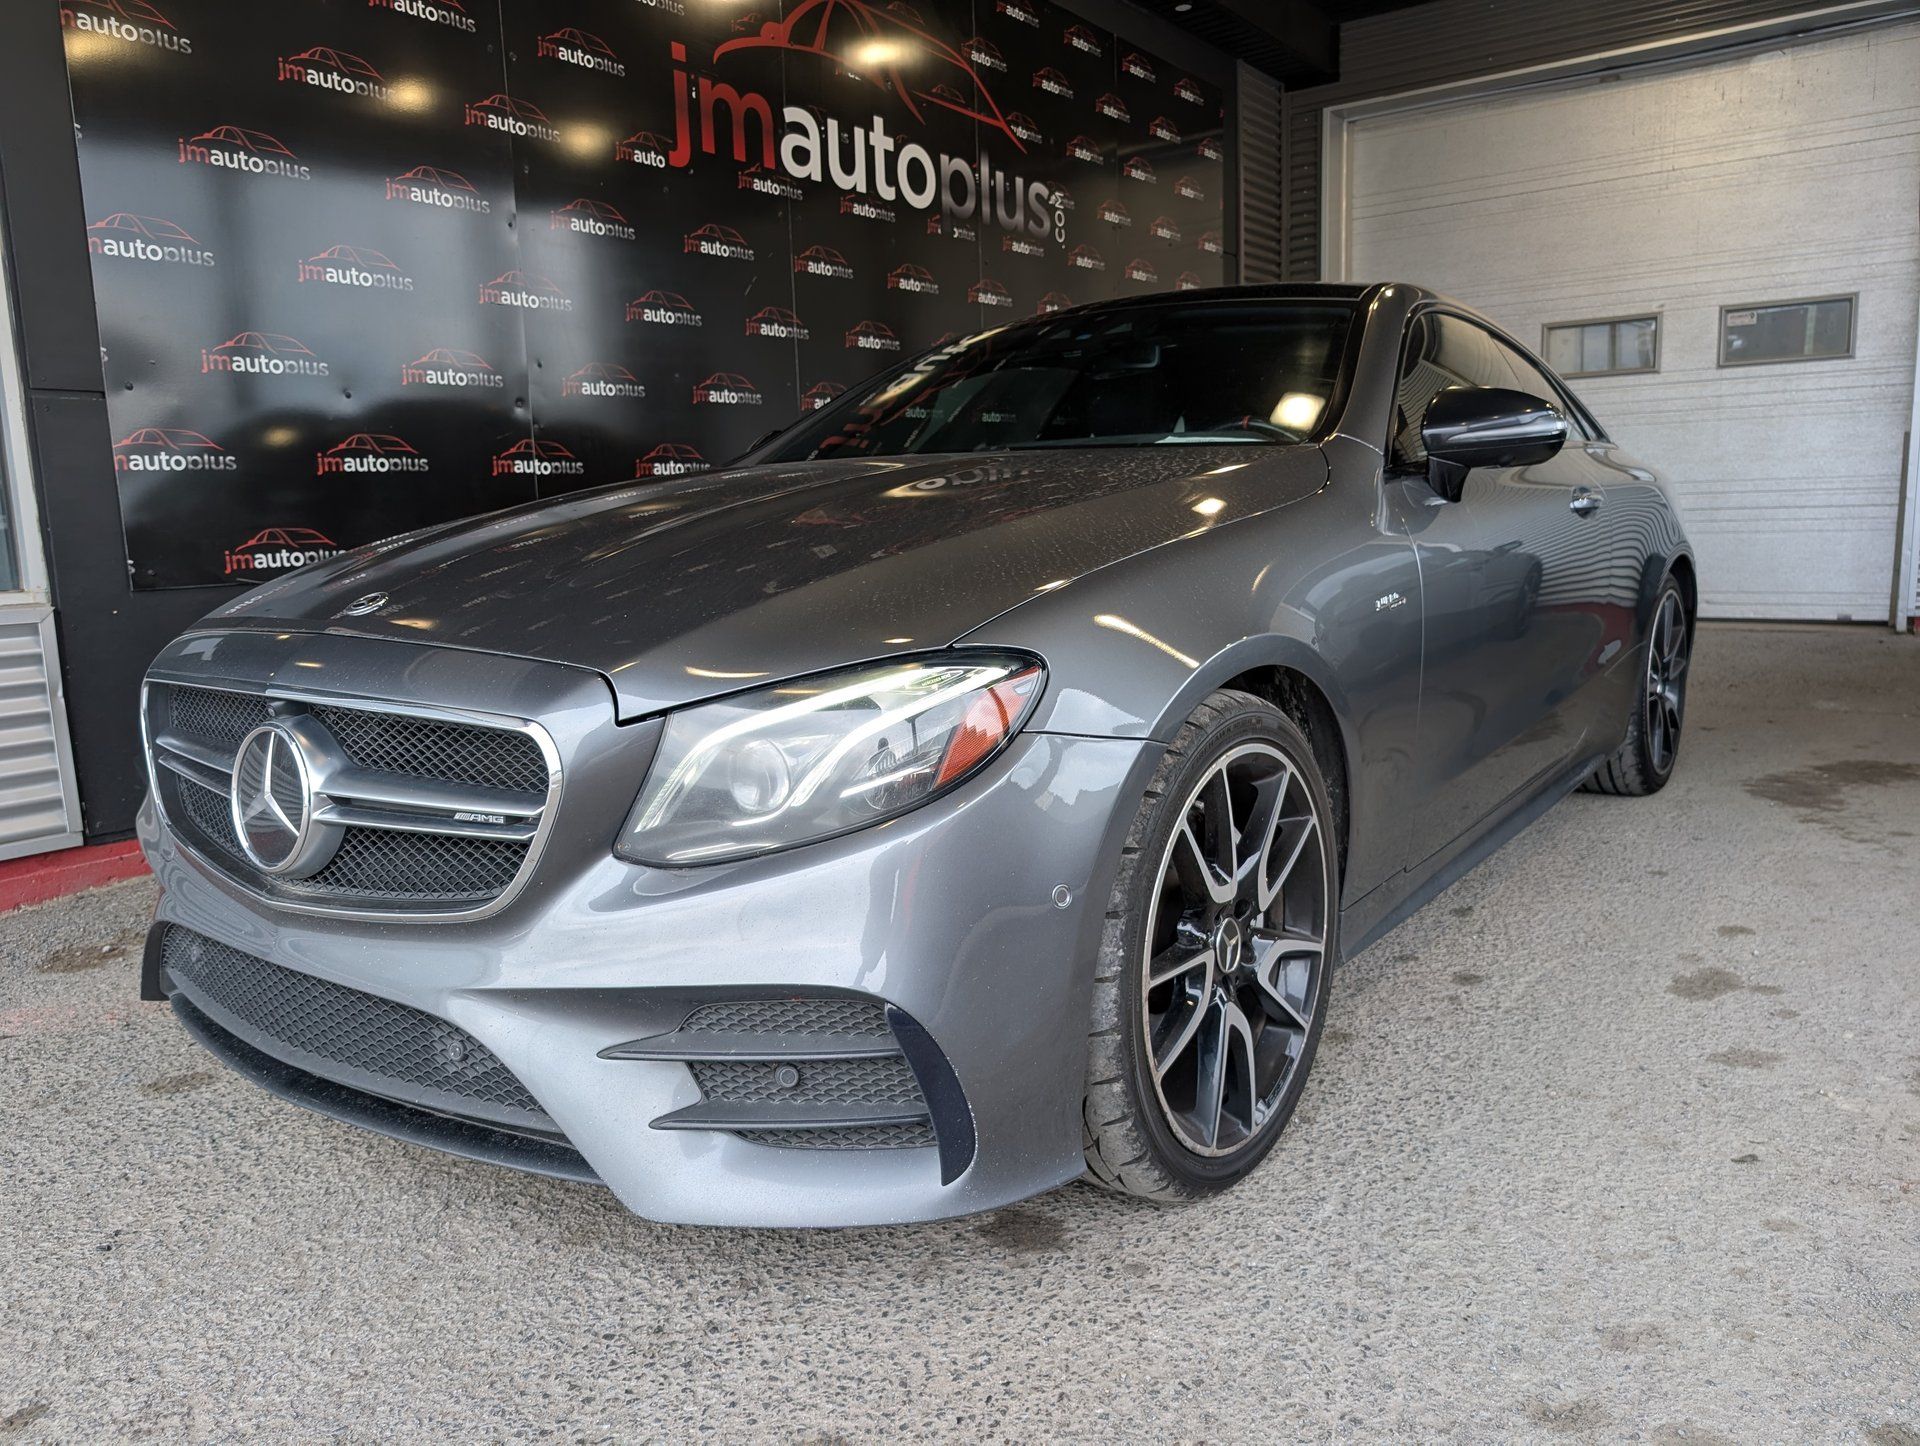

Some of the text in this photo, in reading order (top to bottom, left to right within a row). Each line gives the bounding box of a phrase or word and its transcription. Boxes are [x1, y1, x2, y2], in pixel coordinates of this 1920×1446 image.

[61, 8, 192, 54] mautoplus
[537, 36, 626, 77] jmautoplus
[464, 104, 561, 143] jmautoplus
[668, 41, 1051, 239] jmautoplus
[178, 137, 311, 181] jmautoplus
[615, 142, 666, 168] jmauto
[385, 178, 491, 214] jmautoplus
[550, 210, 636, 241] jmautoplus
[88, 236, 215, 267] mautoplus
[297, 259, 414, 292] jmautoplus
[479, 284, 573, 312] jmautoplus
[625, 303, 703, 327] jmautoplus
[201, 349, 329, 377] jmautoplus
[401, 364, 504, 388] jmautoplus
[562, 377, 646, 398] jmautoplus
[114, 451, 237, 473] mautoplus
[316, 452, 429, 476] jmautoplus
[491, 455, 584, 477] jmautoplus
[224, 549, 347, 575] jmautoplu
[470, 813, 504, 824] AMG
